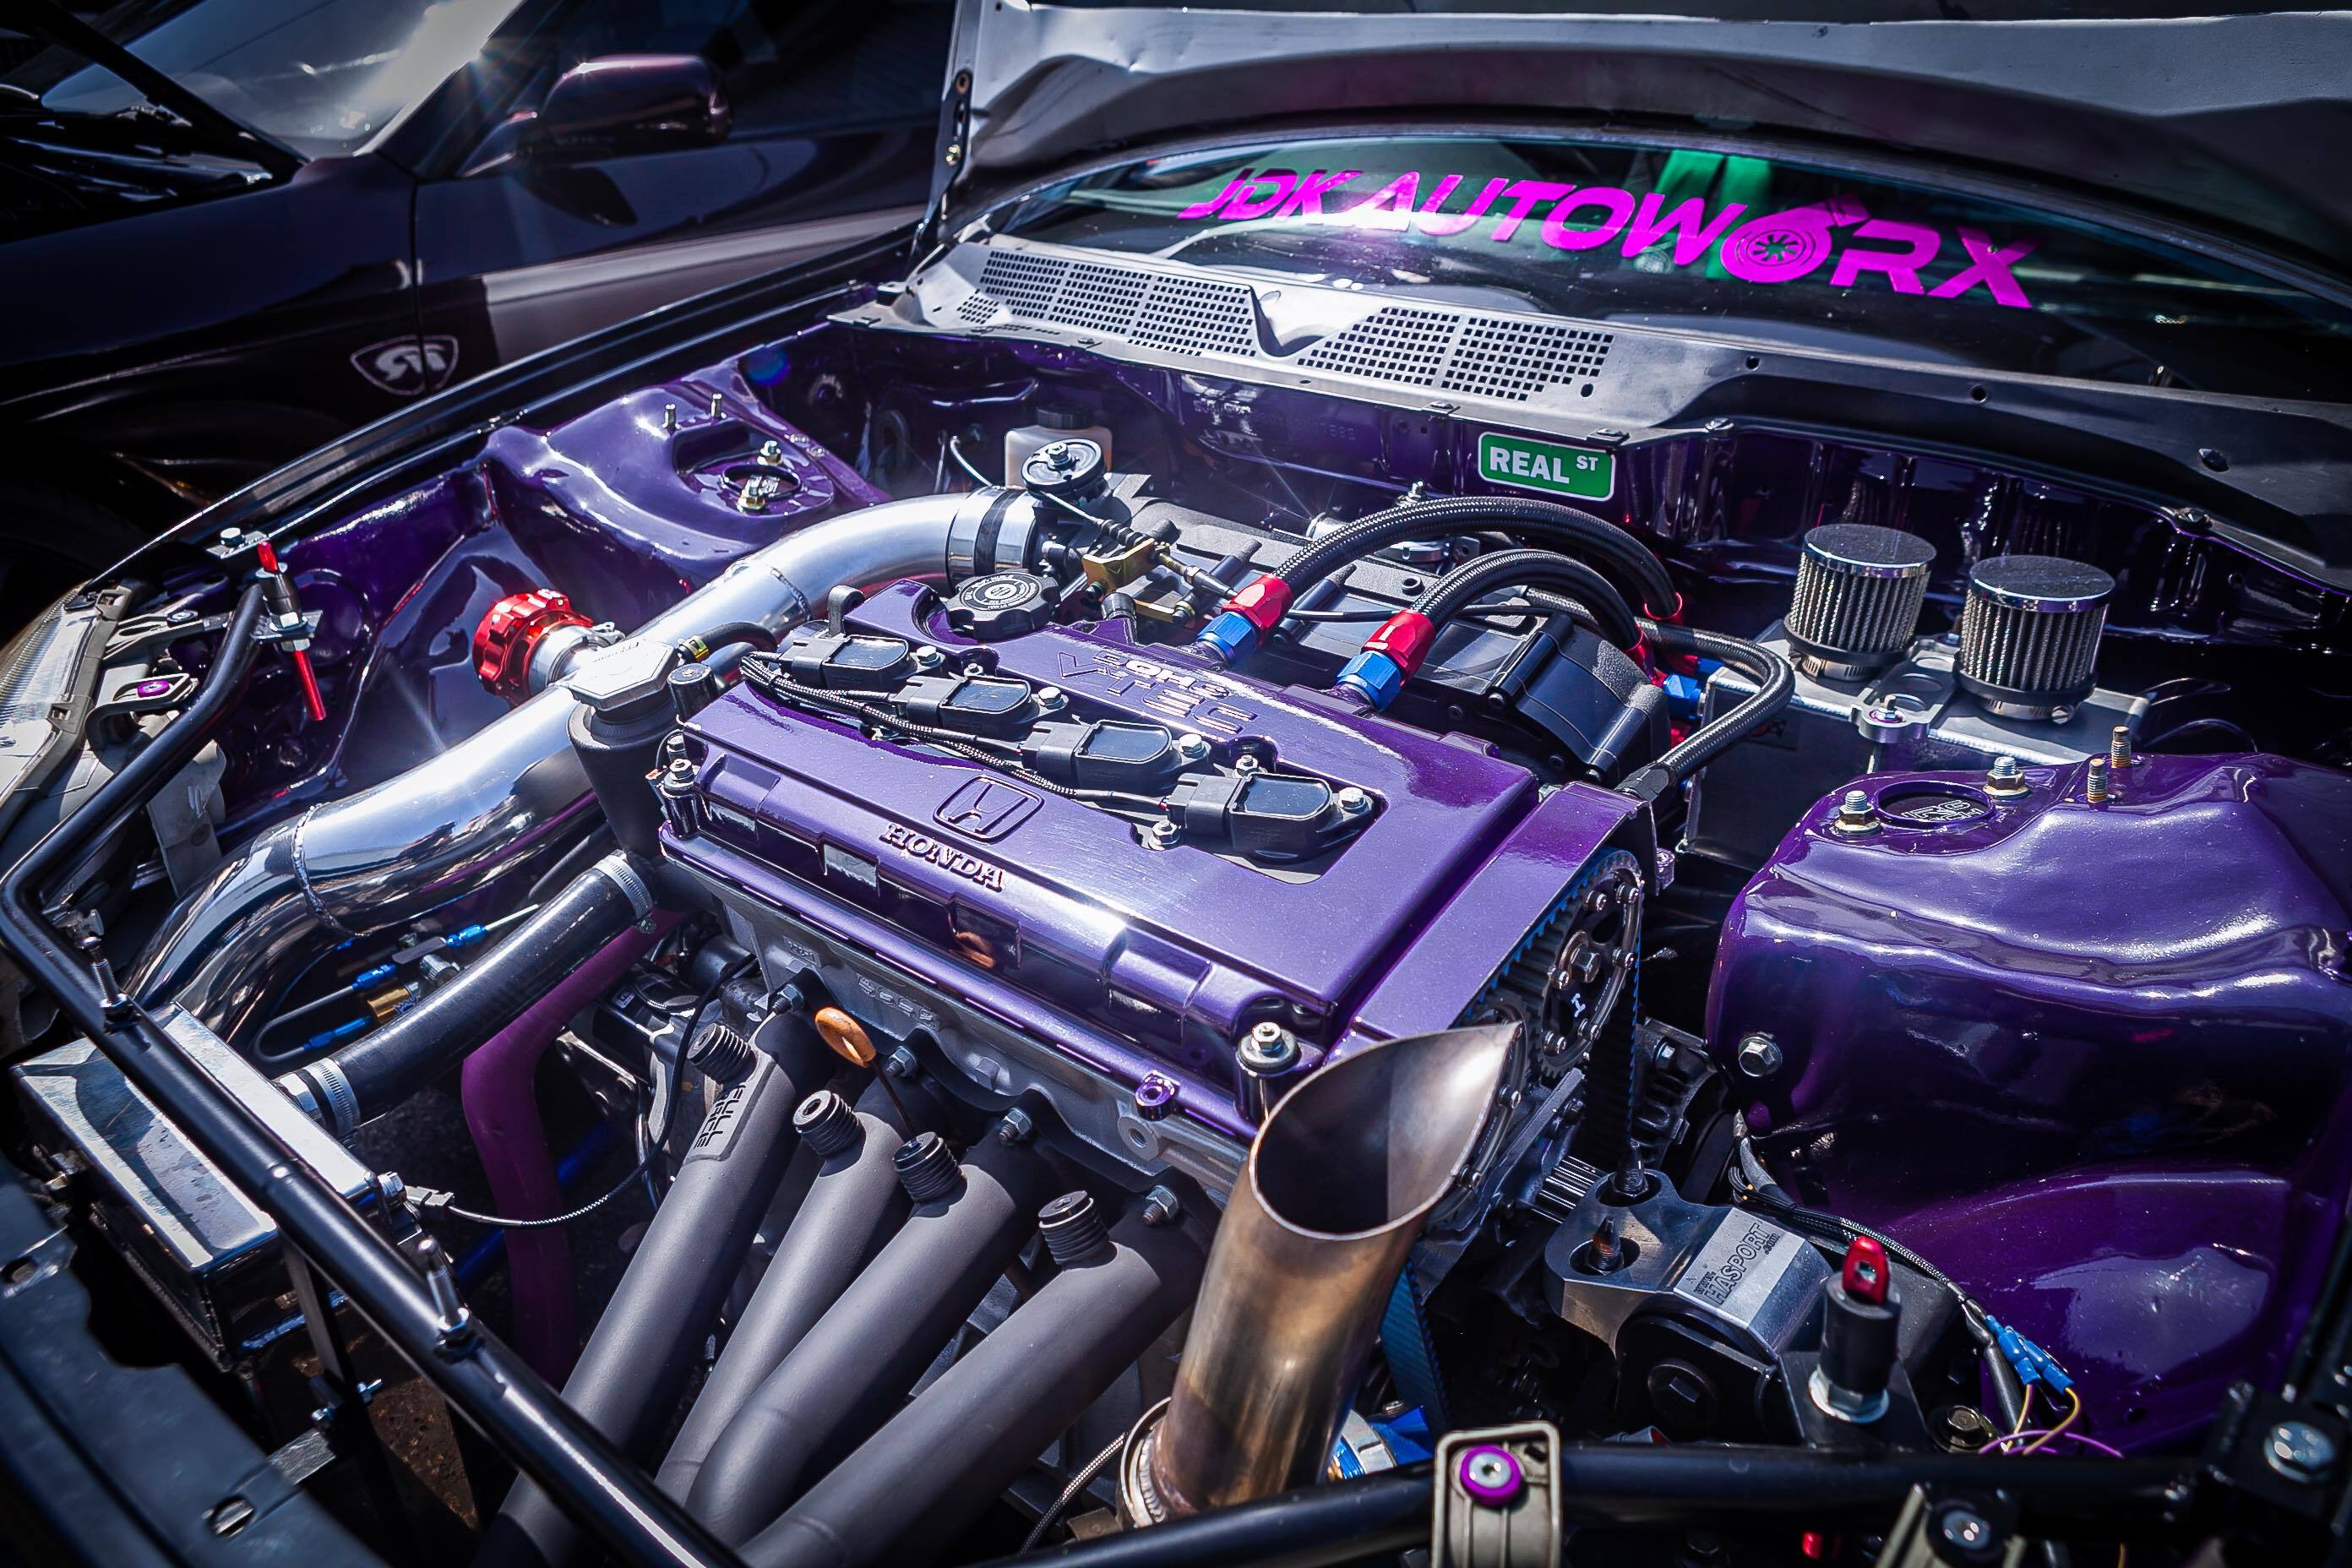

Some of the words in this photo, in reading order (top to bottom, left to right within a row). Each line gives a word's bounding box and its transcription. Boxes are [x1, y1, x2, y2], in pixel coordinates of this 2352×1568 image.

[1176, 168, 1363, 221] JDK
[1489, 446, 1570, 484] REAL
[1576, 455, 1598, 471] ST
[1057, 651, 1258, 734] VTEC
[878, 823, 1007, 893] HONDA
[704, 1085, 747, 1147] FULL
[1704, 1222, 1772, 1305] HASPORT
